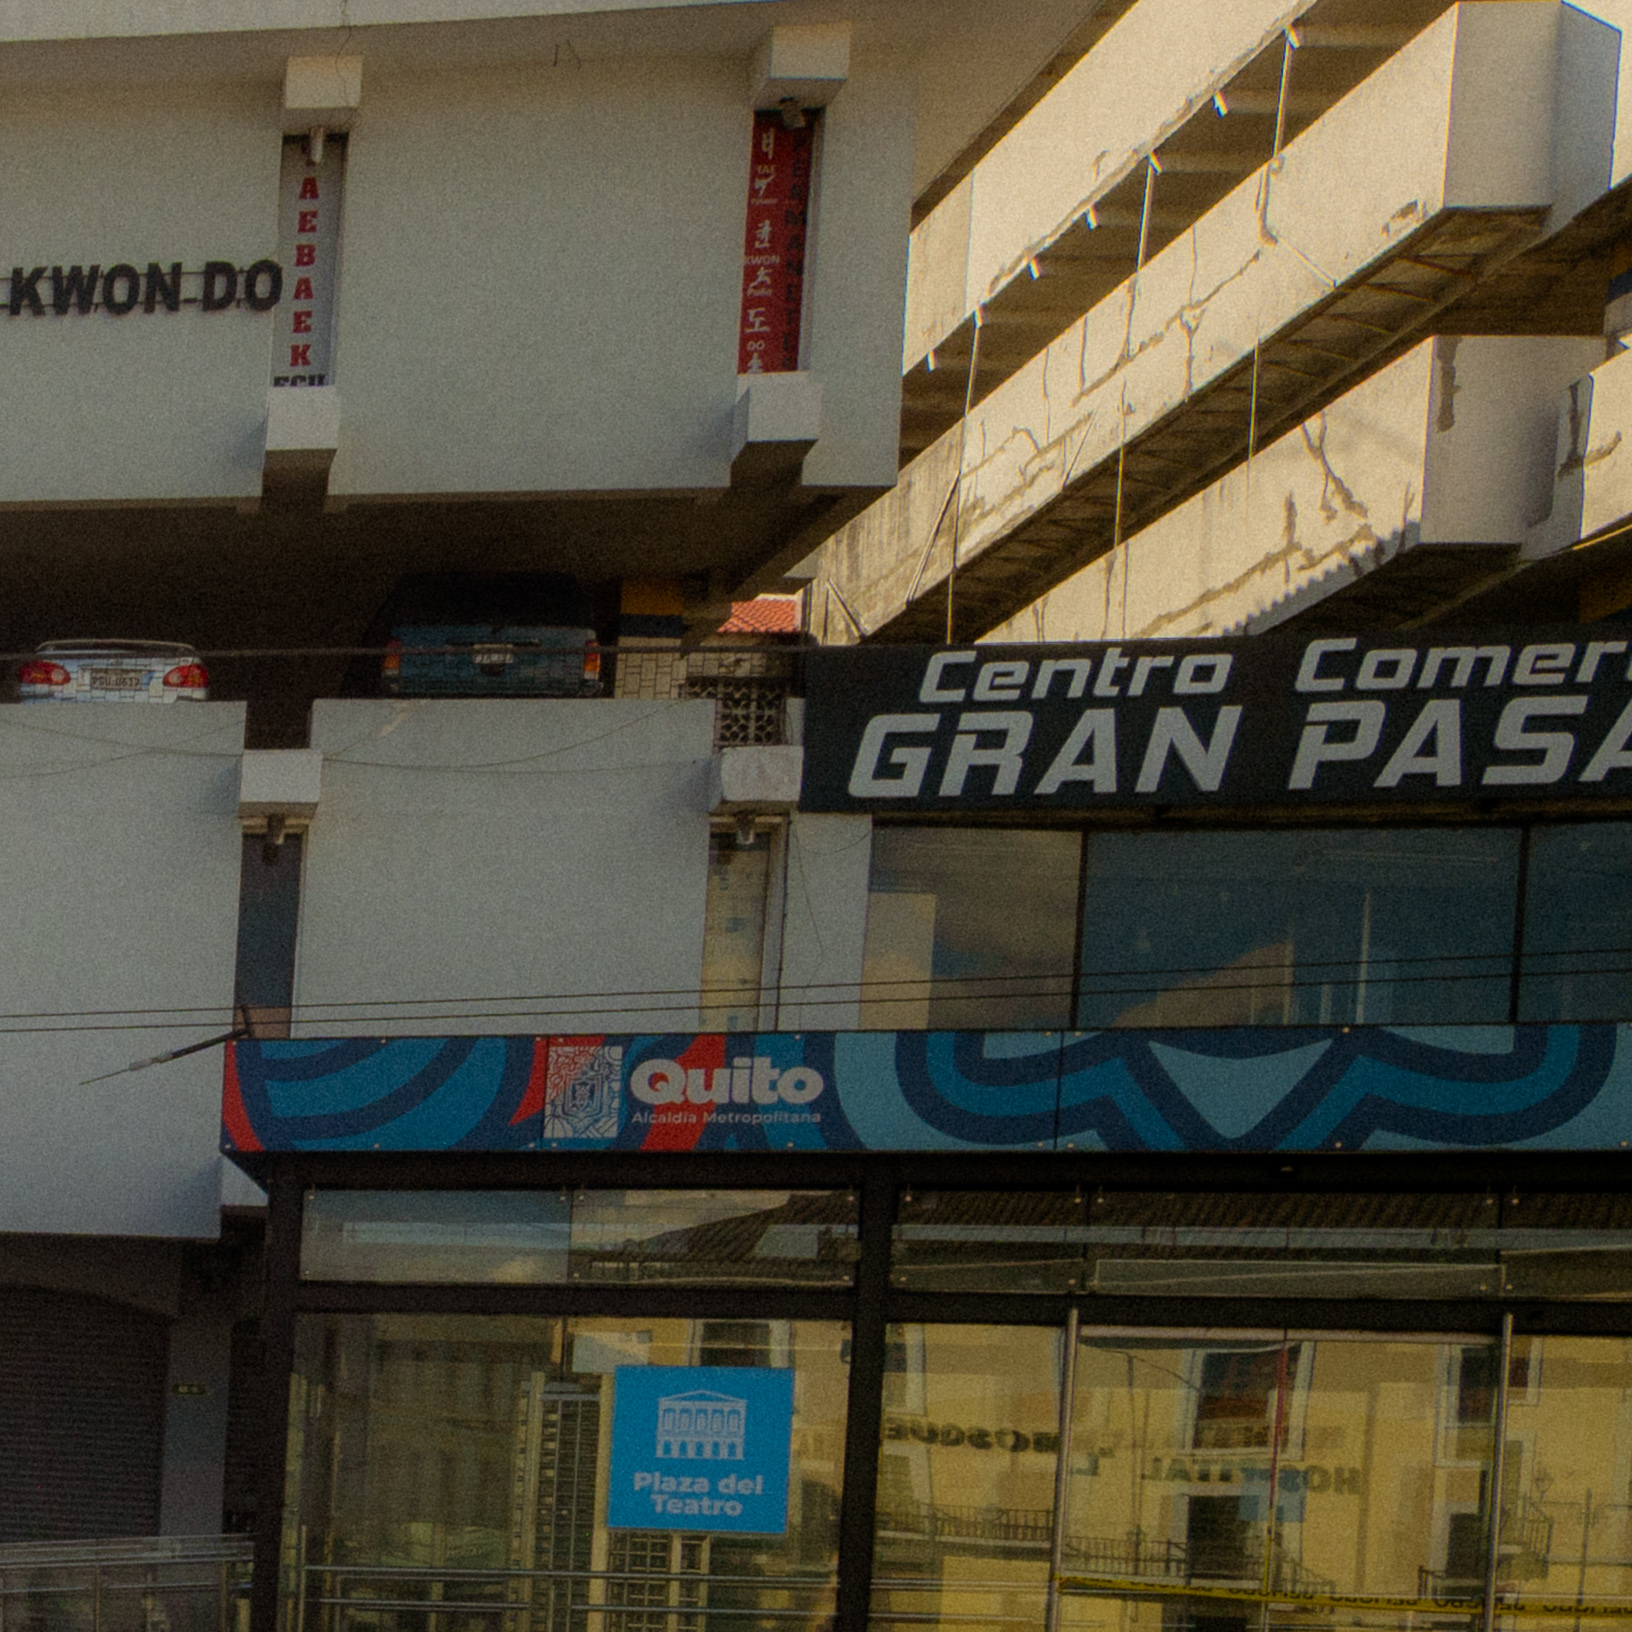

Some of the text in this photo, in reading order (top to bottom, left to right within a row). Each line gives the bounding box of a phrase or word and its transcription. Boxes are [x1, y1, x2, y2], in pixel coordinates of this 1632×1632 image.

[9, 262, 183, 318] KWON
[202, 259, 283, 312] DO
[918, 637, 1632, 704] Centro Comer
[846, 706, 1245, 799] GRAN
[630, 1056, 825, 1105] Quito
[703, 1110, 822, 1126] Metropolitana
[632, 1472, 764, 1496] Plaza del
[650, 1495, 745, 1518] Teatro
